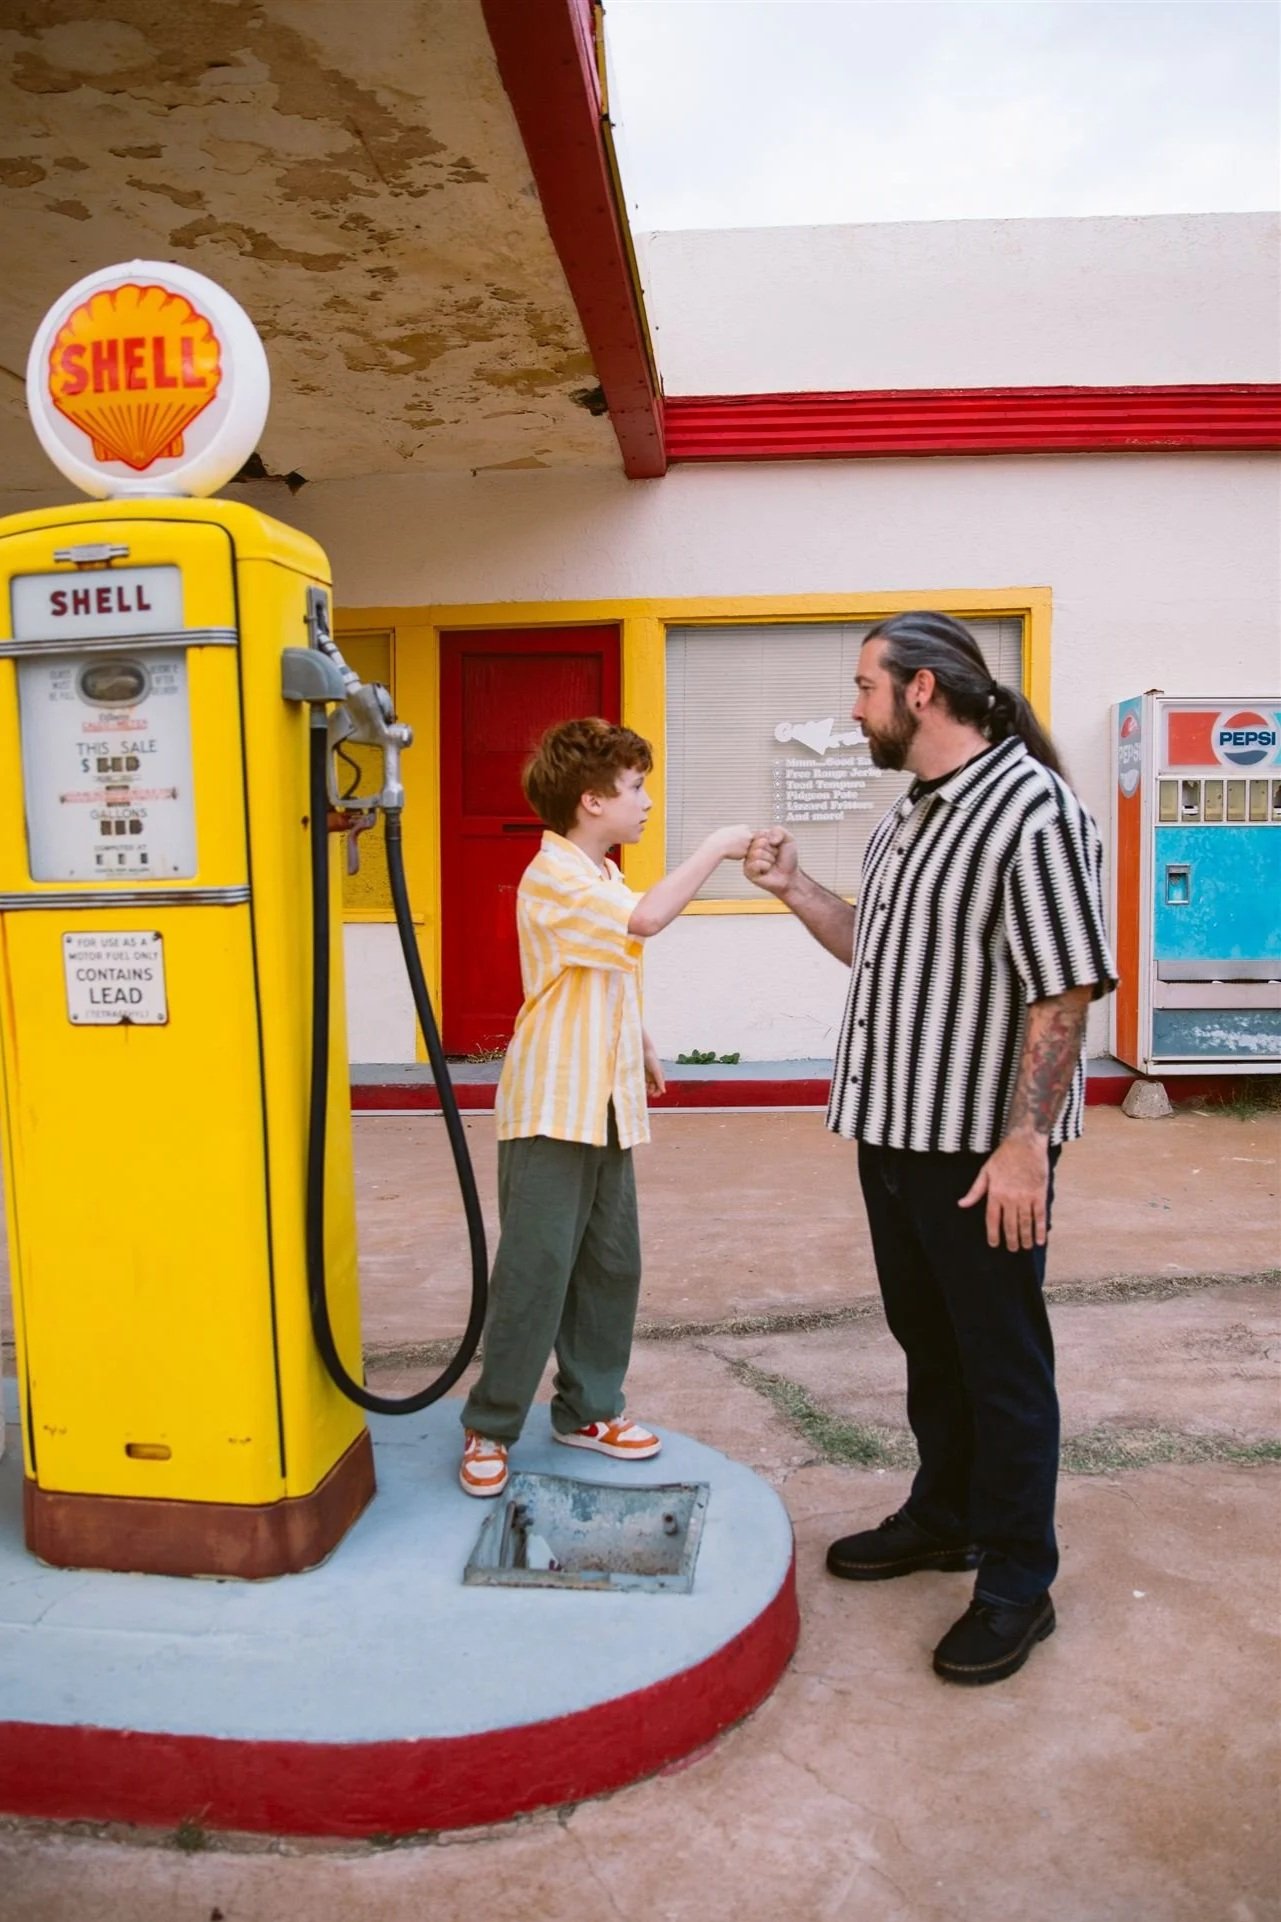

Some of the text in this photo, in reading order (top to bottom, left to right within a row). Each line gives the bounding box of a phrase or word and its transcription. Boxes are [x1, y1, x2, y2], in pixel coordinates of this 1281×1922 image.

[61, 336, 207, 395] SHELL
[50, 585, 151, 617] SHELL
[1219, 731, 1276, 746] PEPSI
[76, 739, 157, 755] THIS SALE
[90, 808, 147, 820] GALLONS
[77, 938, 148, 947] FOR USE AS A
[106, 952, 129, 960] FUEL
[135, 951, 158, 960] ONLY
[76, 967, 153, 982] CONTAINS
[89, 987, 142, 1004] LEAD
